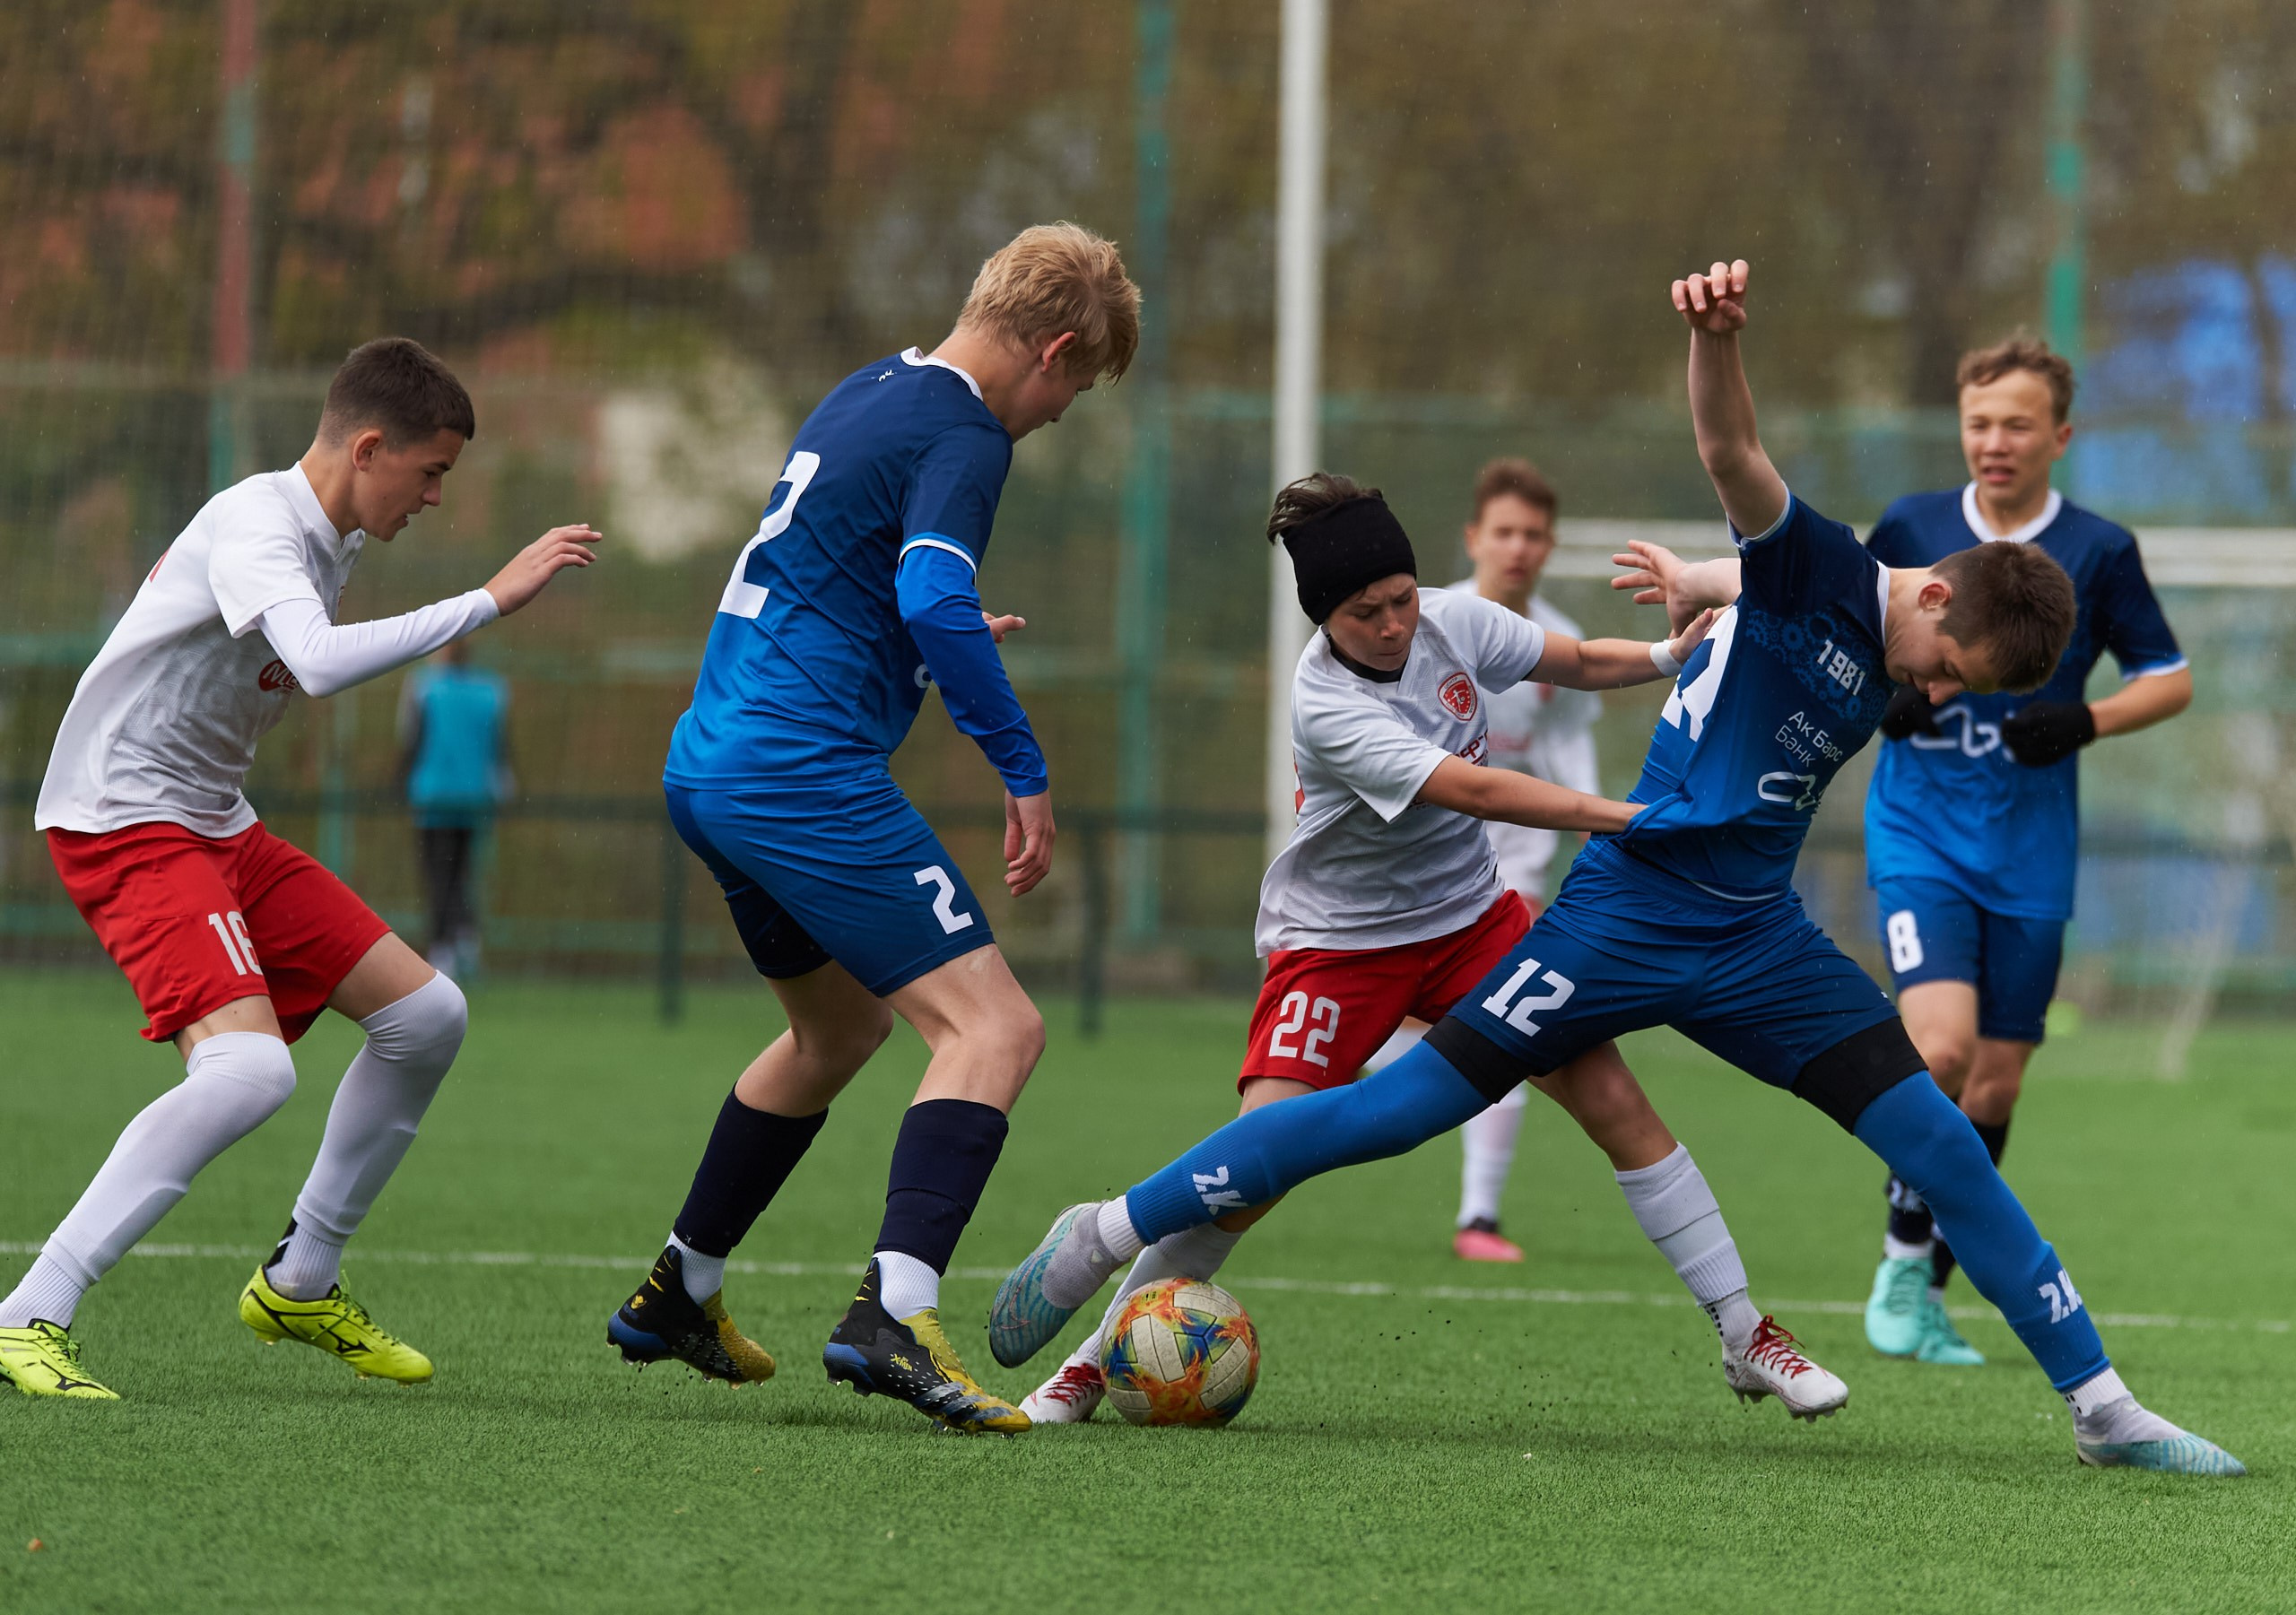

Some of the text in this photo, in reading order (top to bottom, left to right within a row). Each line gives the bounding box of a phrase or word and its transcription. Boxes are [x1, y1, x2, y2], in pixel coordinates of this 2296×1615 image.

[717, 451, 821, 620] 2
[1816, 639, 1866, 696] 1981
[1775, 725, 1816, 768] Банк
[1788, 710, 1843, 762] Ак Барс
[914, 864, 974, 934] 2
[1887, 909, 1924, 973] 8
[1268, 991, 1341, 1068] 22
[1481, 958, 1575, 1038] 12
